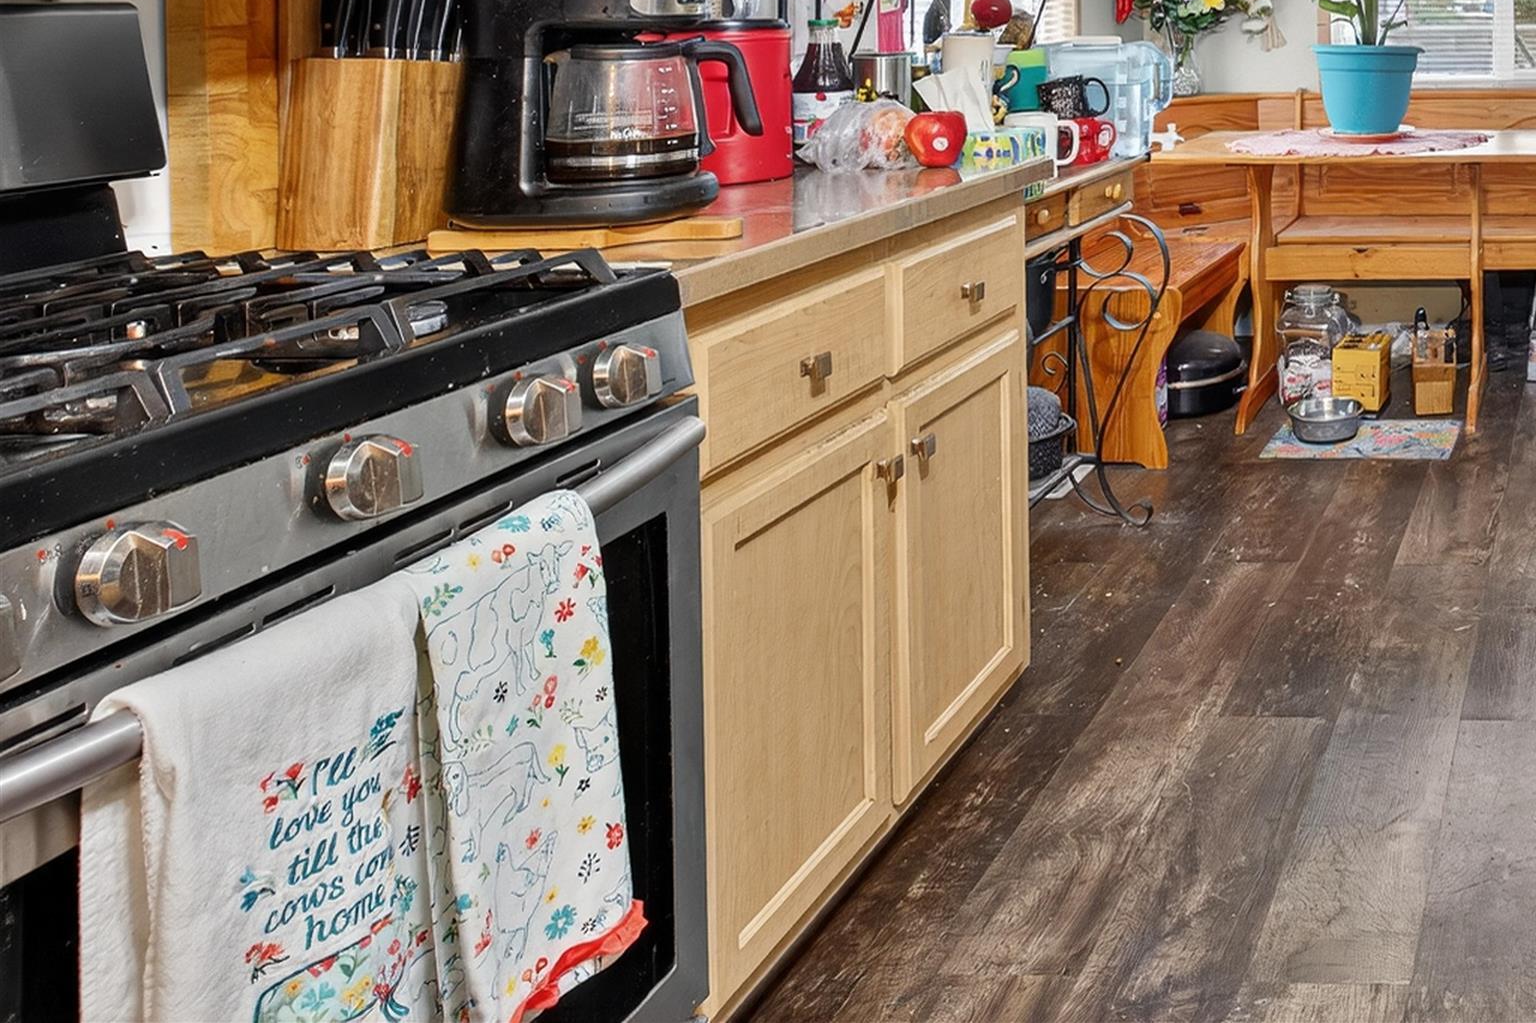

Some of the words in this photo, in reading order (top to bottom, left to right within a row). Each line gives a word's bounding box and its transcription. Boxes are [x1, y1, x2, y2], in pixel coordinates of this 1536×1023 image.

[269, 800, 333, 850] love
[341, 773, 381, 827] you
[288, 832, 339, 886] till
[346, 817, 383, 855] the
[264, 876, 345, 934] cows
[304, 883, 386, 951] home
